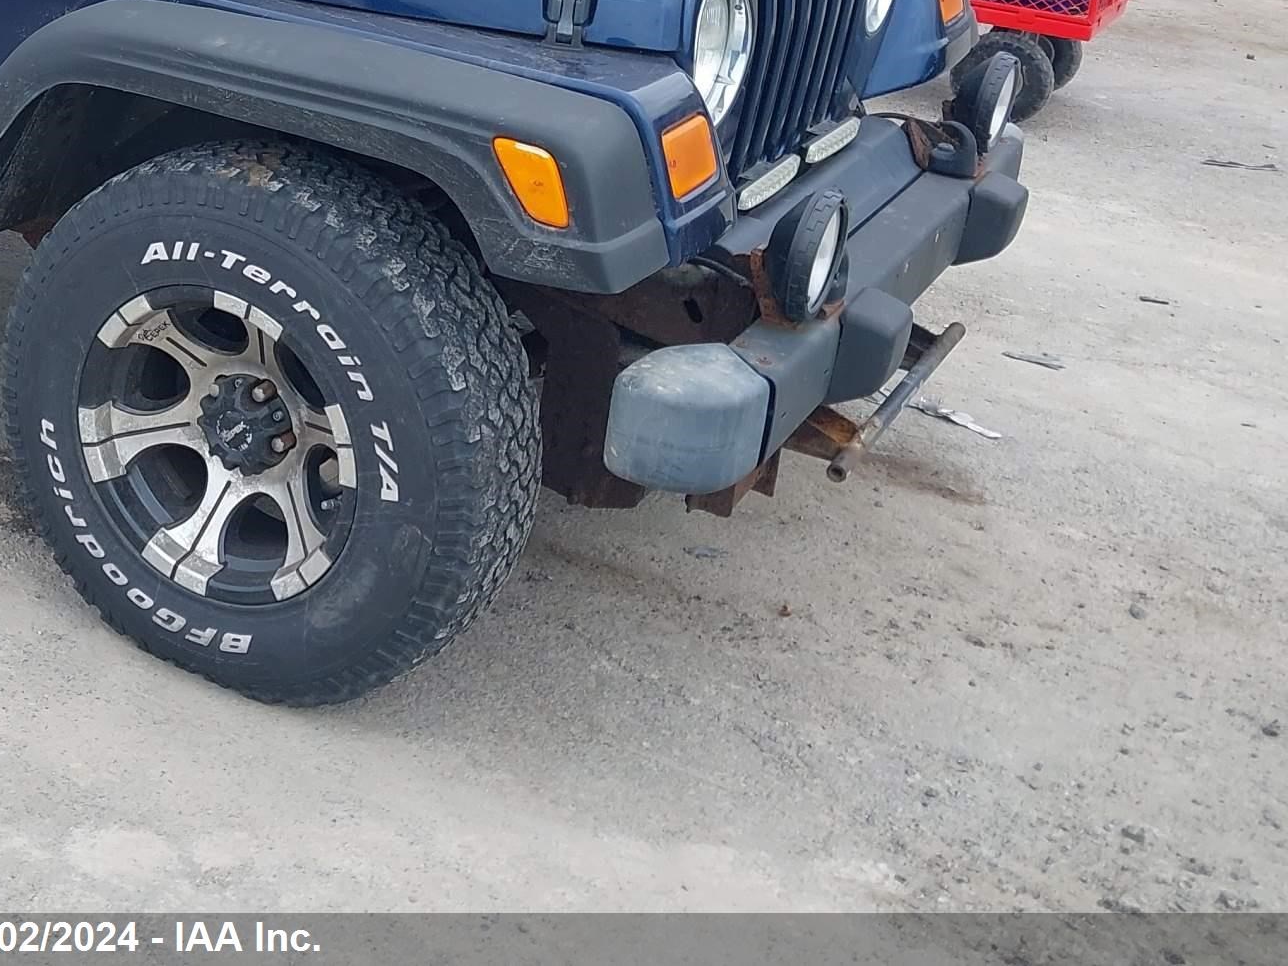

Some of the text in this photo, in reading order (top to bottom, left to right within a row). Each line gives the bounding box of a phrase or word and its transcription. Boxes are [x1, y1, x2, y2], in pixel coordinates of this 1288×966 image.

[140, 240, 401, 503] All-Terrain T/A
[39, 417, 253, 655] BFGoodrich
